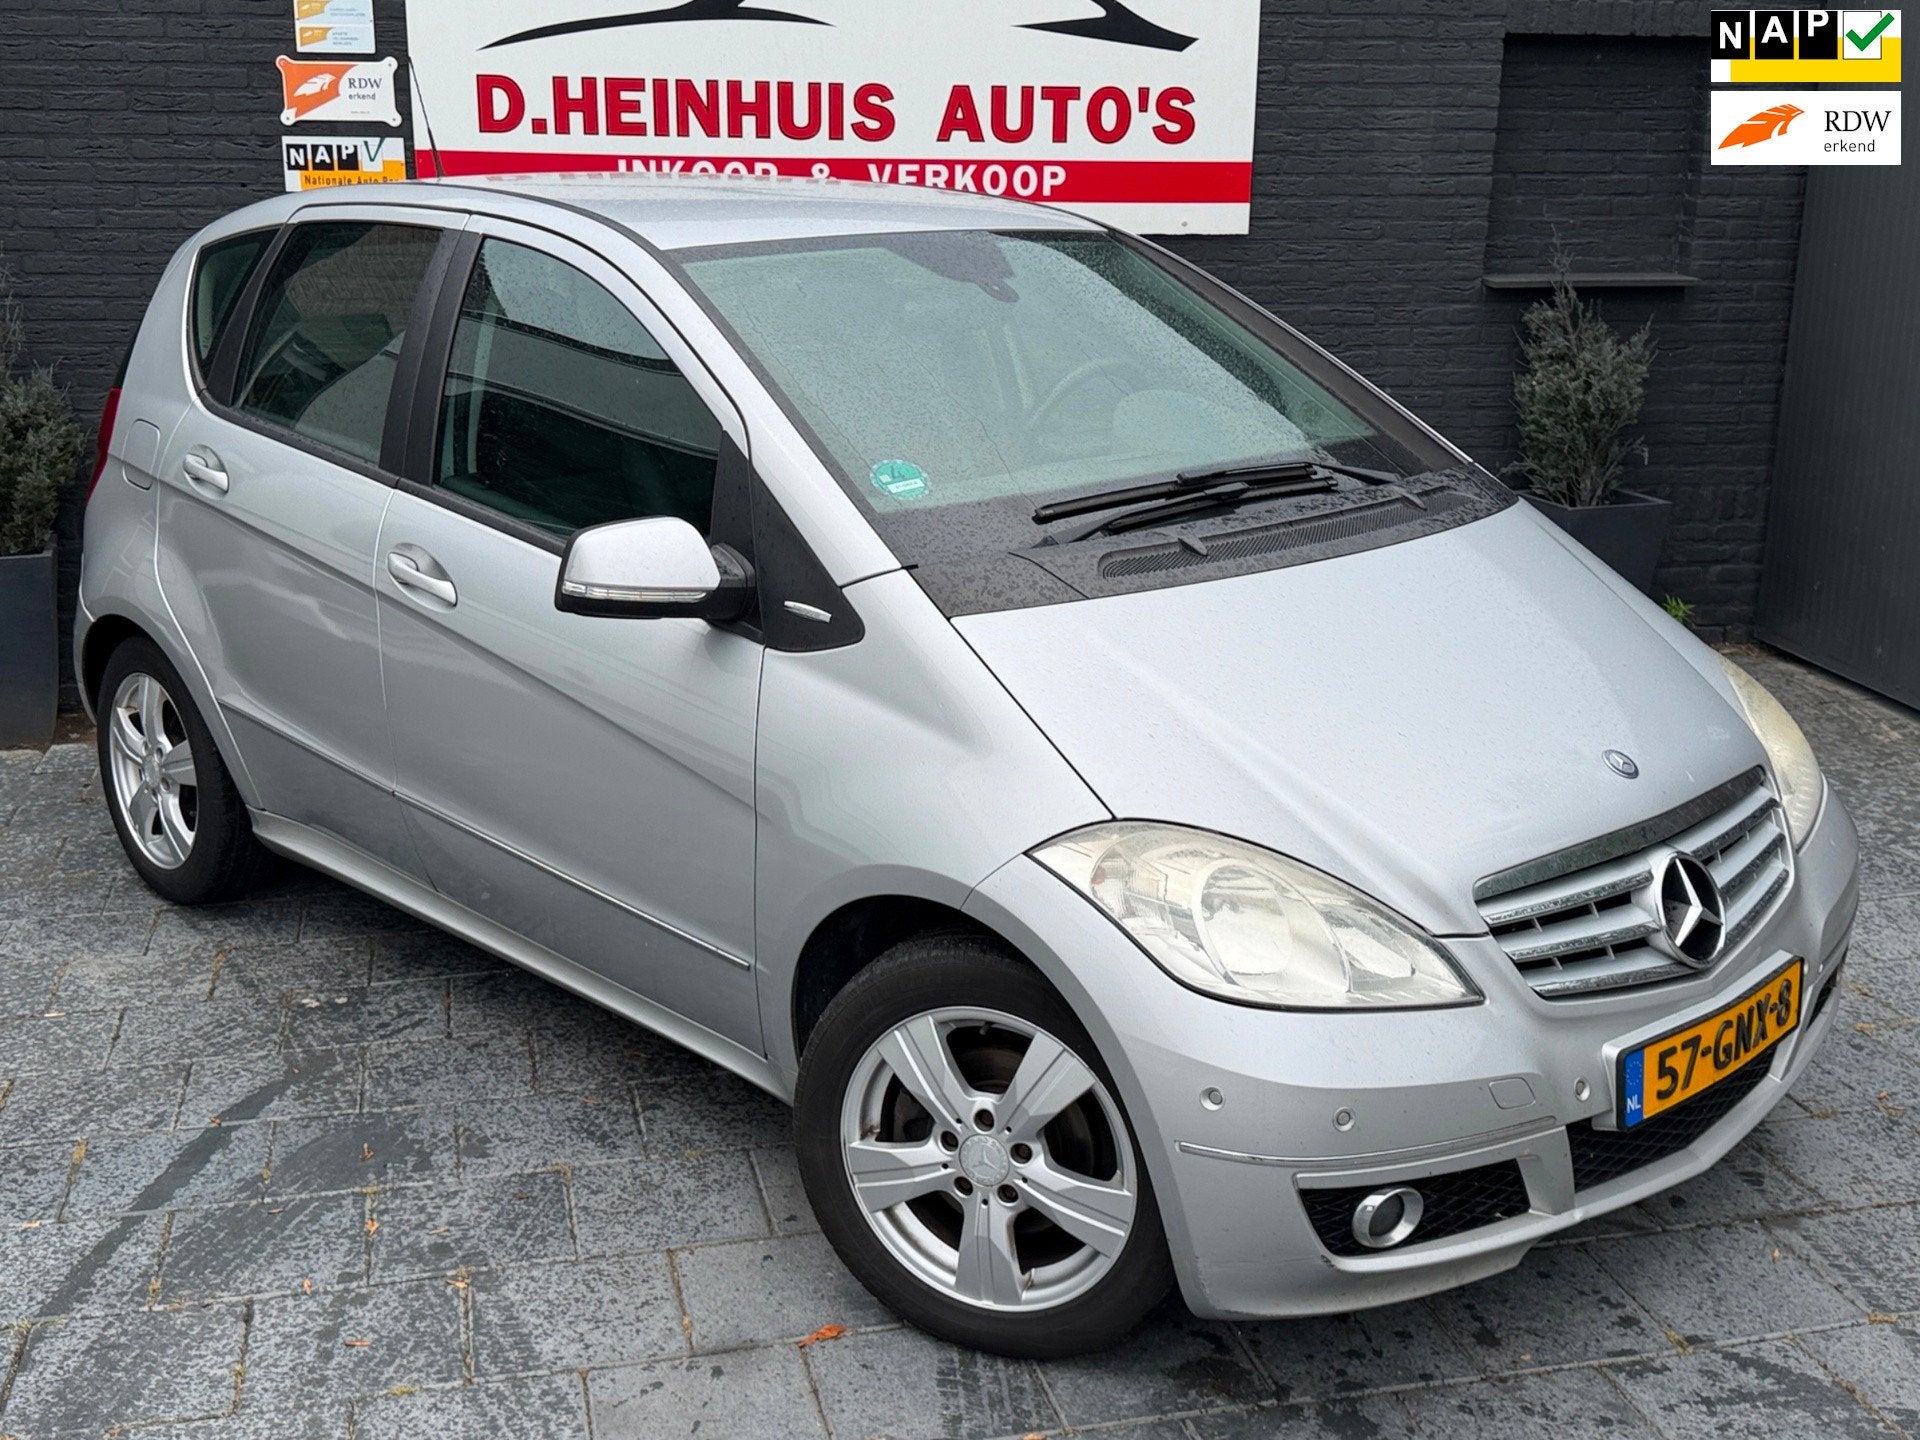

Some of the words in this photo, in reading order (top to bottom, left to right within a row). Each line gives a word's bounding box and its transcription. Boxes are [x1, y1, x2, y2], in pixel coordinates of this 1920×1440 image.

[348, 77, 383, 89] RDW
[348, 92, 376, 100] erkend
[476, 74, 896, 142] D.HEINHUIS
[936, 85, 1196, 144] AUTO'S
[289, 144, 355, 166] NAP
[867, 163, 1067, 197] VERKOOP
[1656, 978, 1793, 1101] 57-GNX-8
[1626, 1094, 1642, 1114] NL
